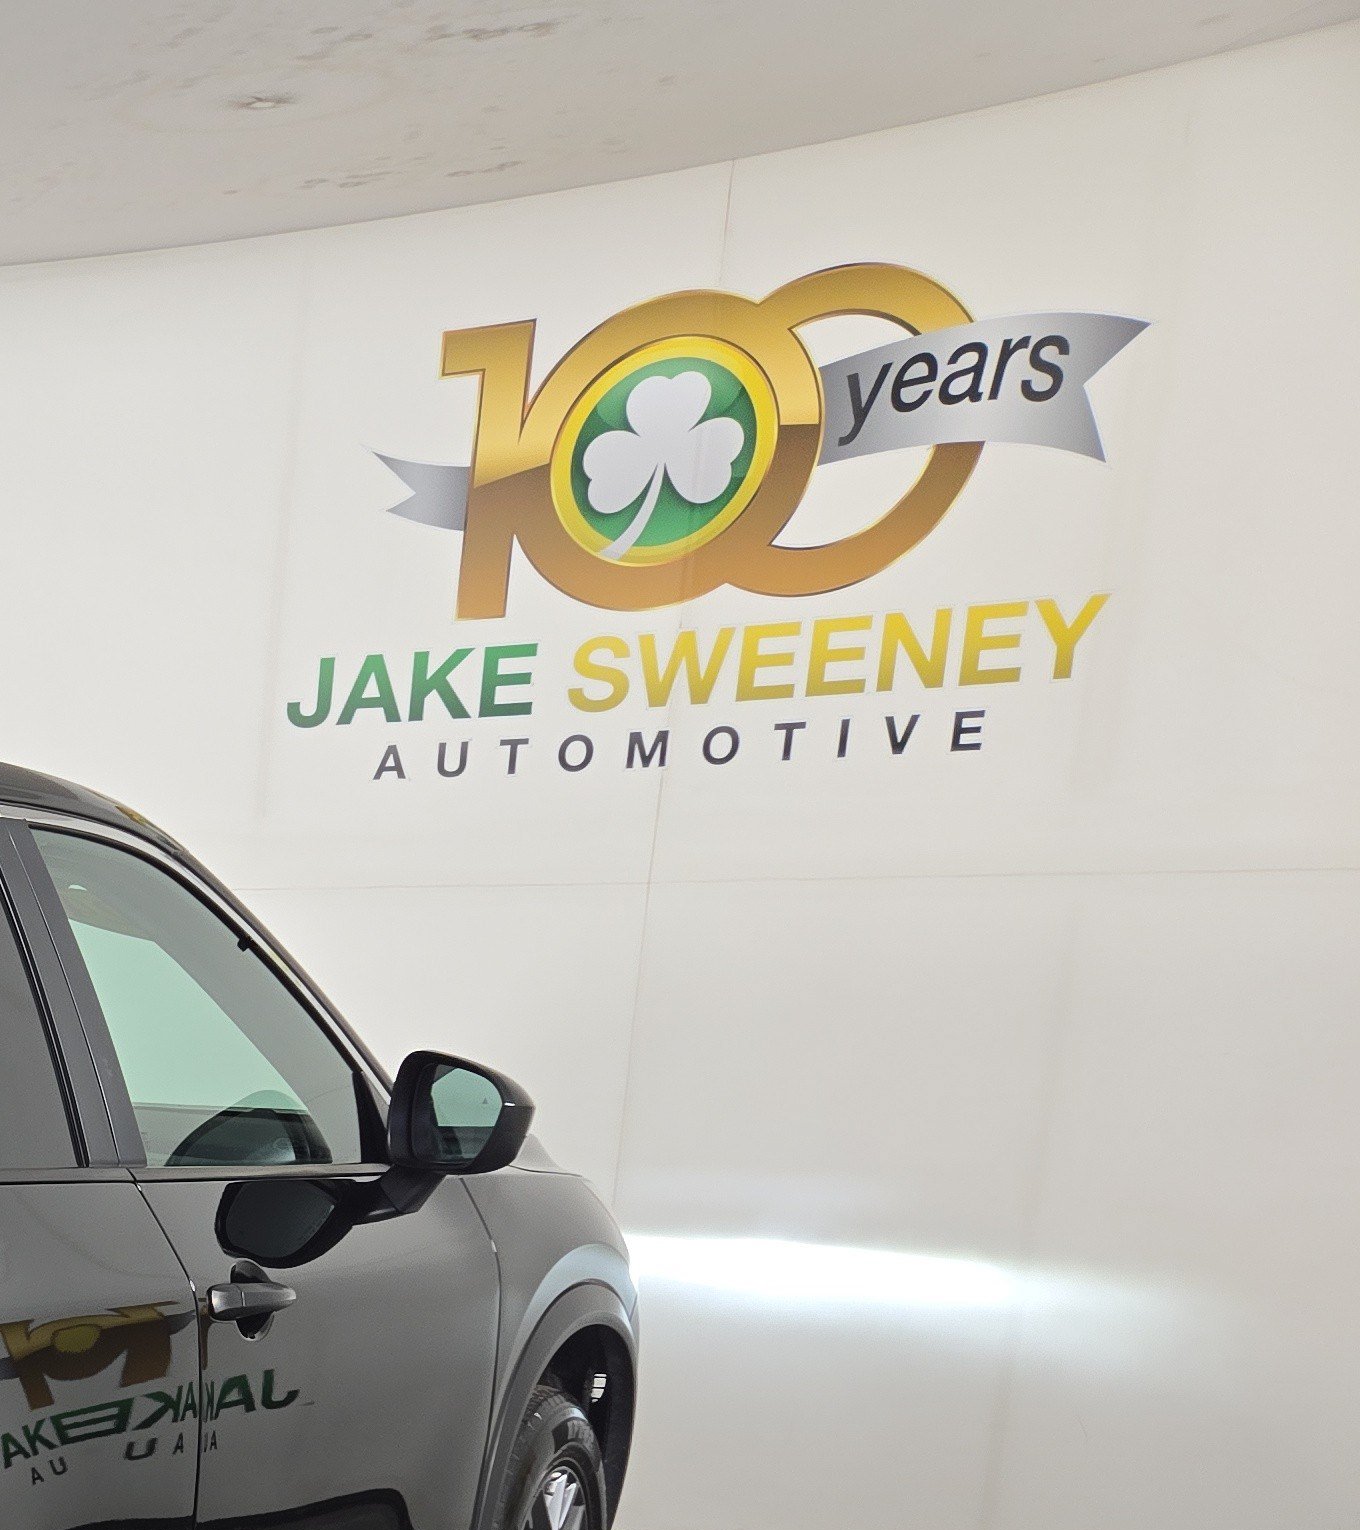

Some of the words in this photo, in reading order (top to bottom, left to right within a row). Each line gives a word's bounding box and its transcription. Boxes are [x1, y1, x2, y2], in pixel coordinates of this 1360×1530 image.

[441, 261, 986, 620] 100
[838, 333, 1070, 444] years
[286, 643, 539, 729] JAKE
[567, 593, 1111, 712] SWEENEY
[373, 710, 986, 780] AUTOMOTIVE
